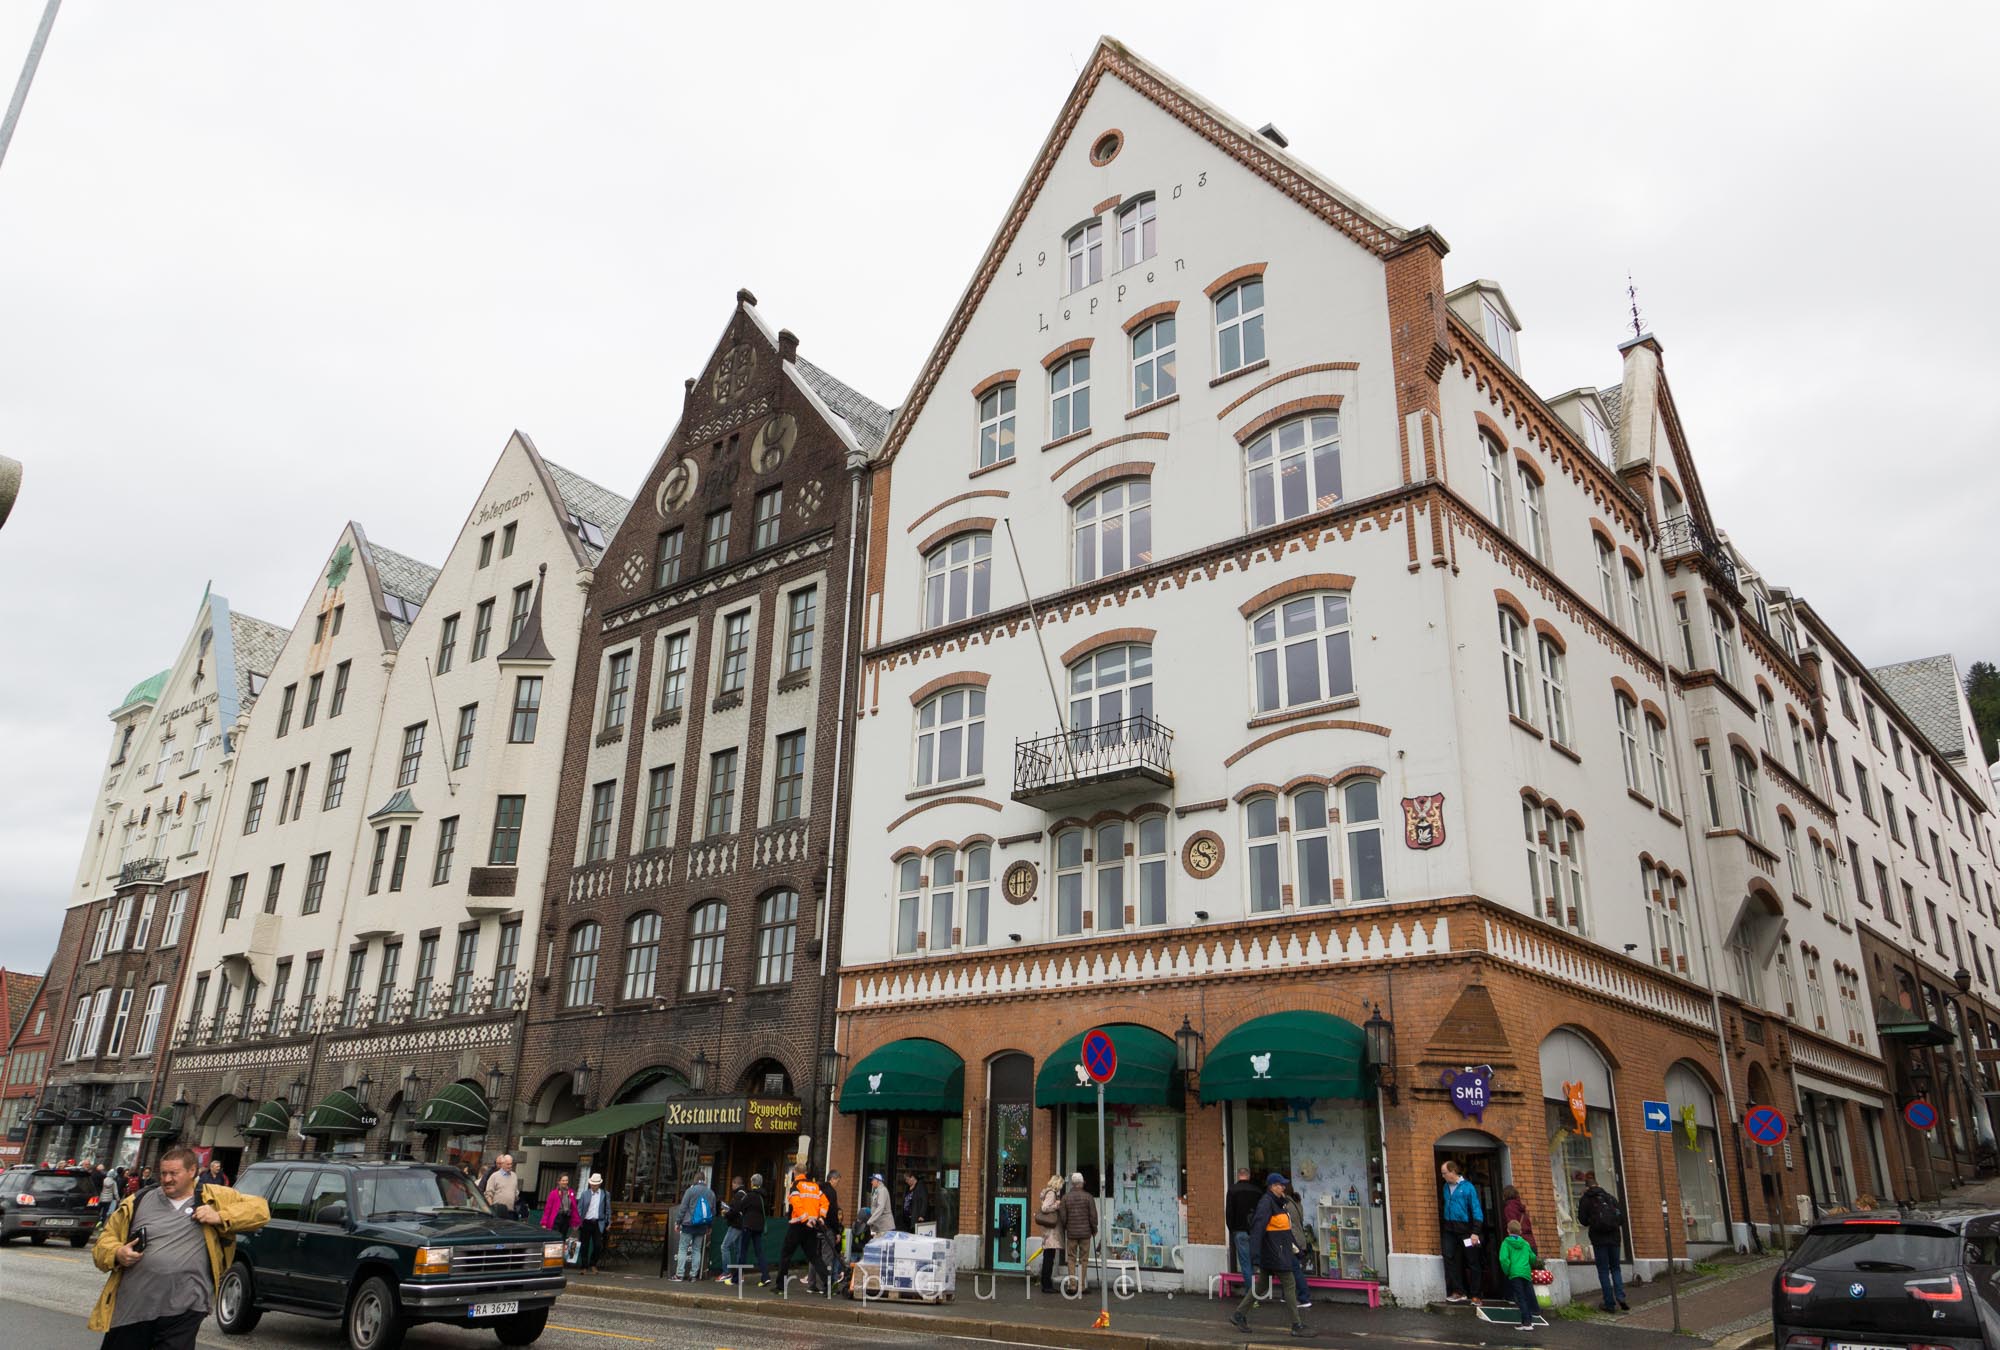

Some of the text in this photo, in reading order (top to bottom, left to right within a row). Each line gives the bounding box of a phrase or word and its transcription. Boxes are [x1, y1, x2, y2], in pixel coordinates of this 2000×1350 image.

[1038, 257, 1185, 332] Leppen
[1456, 1078, 1483, 1099] SMÅ
[748, 1100, 802, 1117] Bryggeloftet
[1470, 1099, 1484, 1107] ting
[667, 1103, 742, 1125] Restaurant
[754, 1116, 763, 1130] &
[475, 1302, 517, 1315] RA 36272
